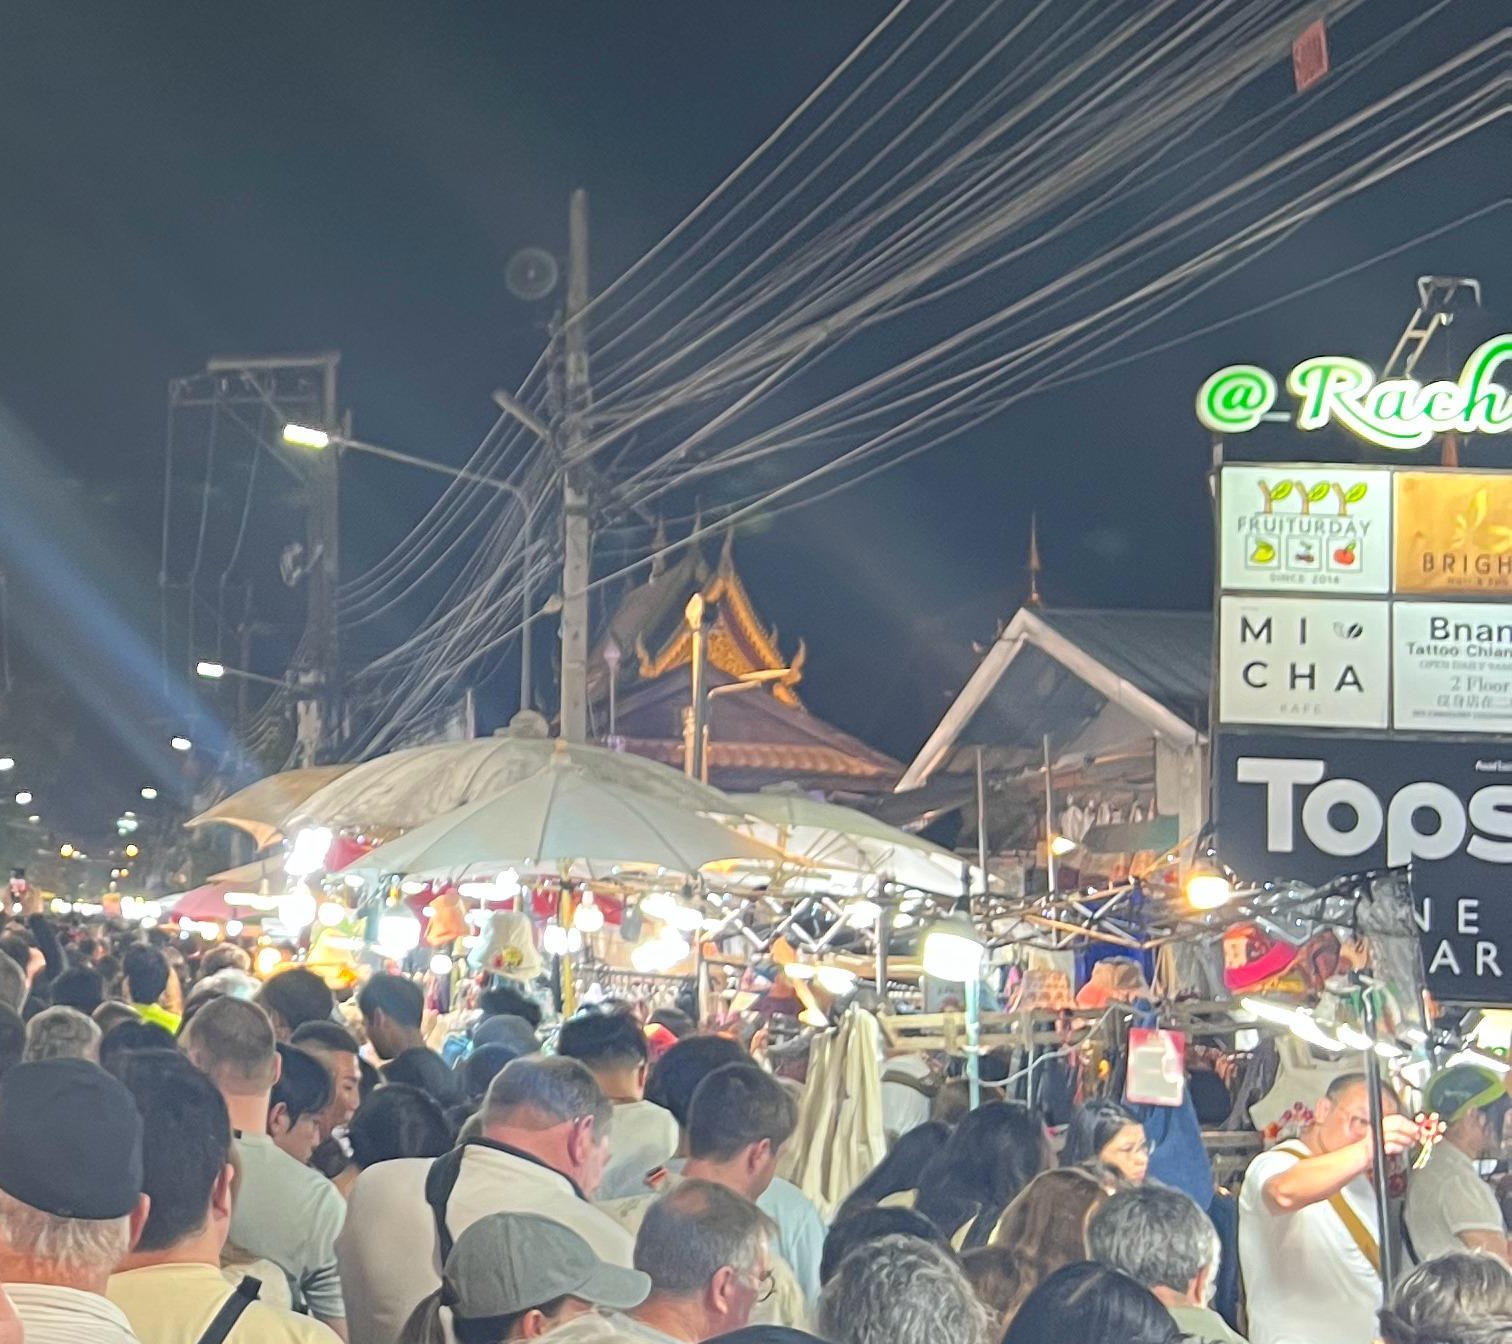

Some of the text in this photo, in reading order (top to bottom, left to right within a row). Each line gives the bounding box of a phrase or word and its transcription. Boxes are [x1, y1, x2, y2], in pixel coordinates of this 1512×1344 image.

[1238, 516, 1371, 539] FRUITURDAY
[1422, 552, 1512, 575] BRIGH
[1407, 642, 1460, 656] Tattoo
[1243, 661, 1364, 693] CHA
[1449, 676, 1510, 693] 2 Floor
[1237, 757, 1512, 869] Tops
